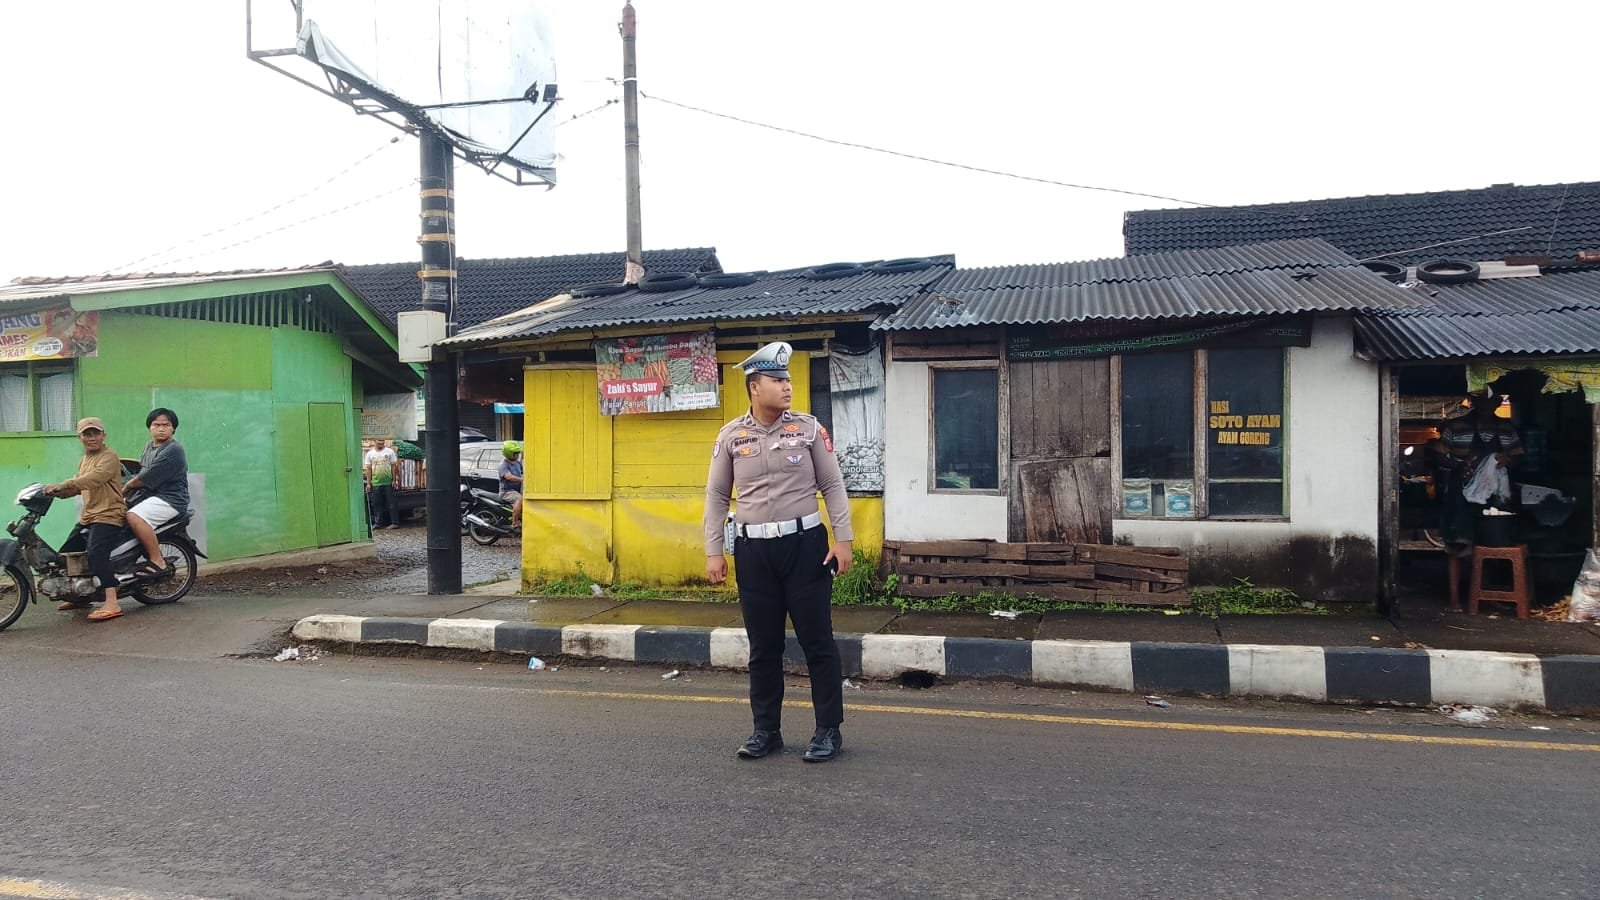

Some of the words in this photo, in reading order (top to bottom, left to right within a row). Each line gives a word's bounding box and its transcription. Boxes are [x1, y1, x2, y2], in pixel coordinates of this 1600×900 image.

[607, 384, 631, 394] Zaki's
[632, 382, 658, 393] Sayur
[1210, 416, 1243, 428] SOTO
[1247, 415, 1280, 428] AYAM
[1218, 432, 1238, 443] AYAM
[1240, 432, 1270, 444] GORENG
